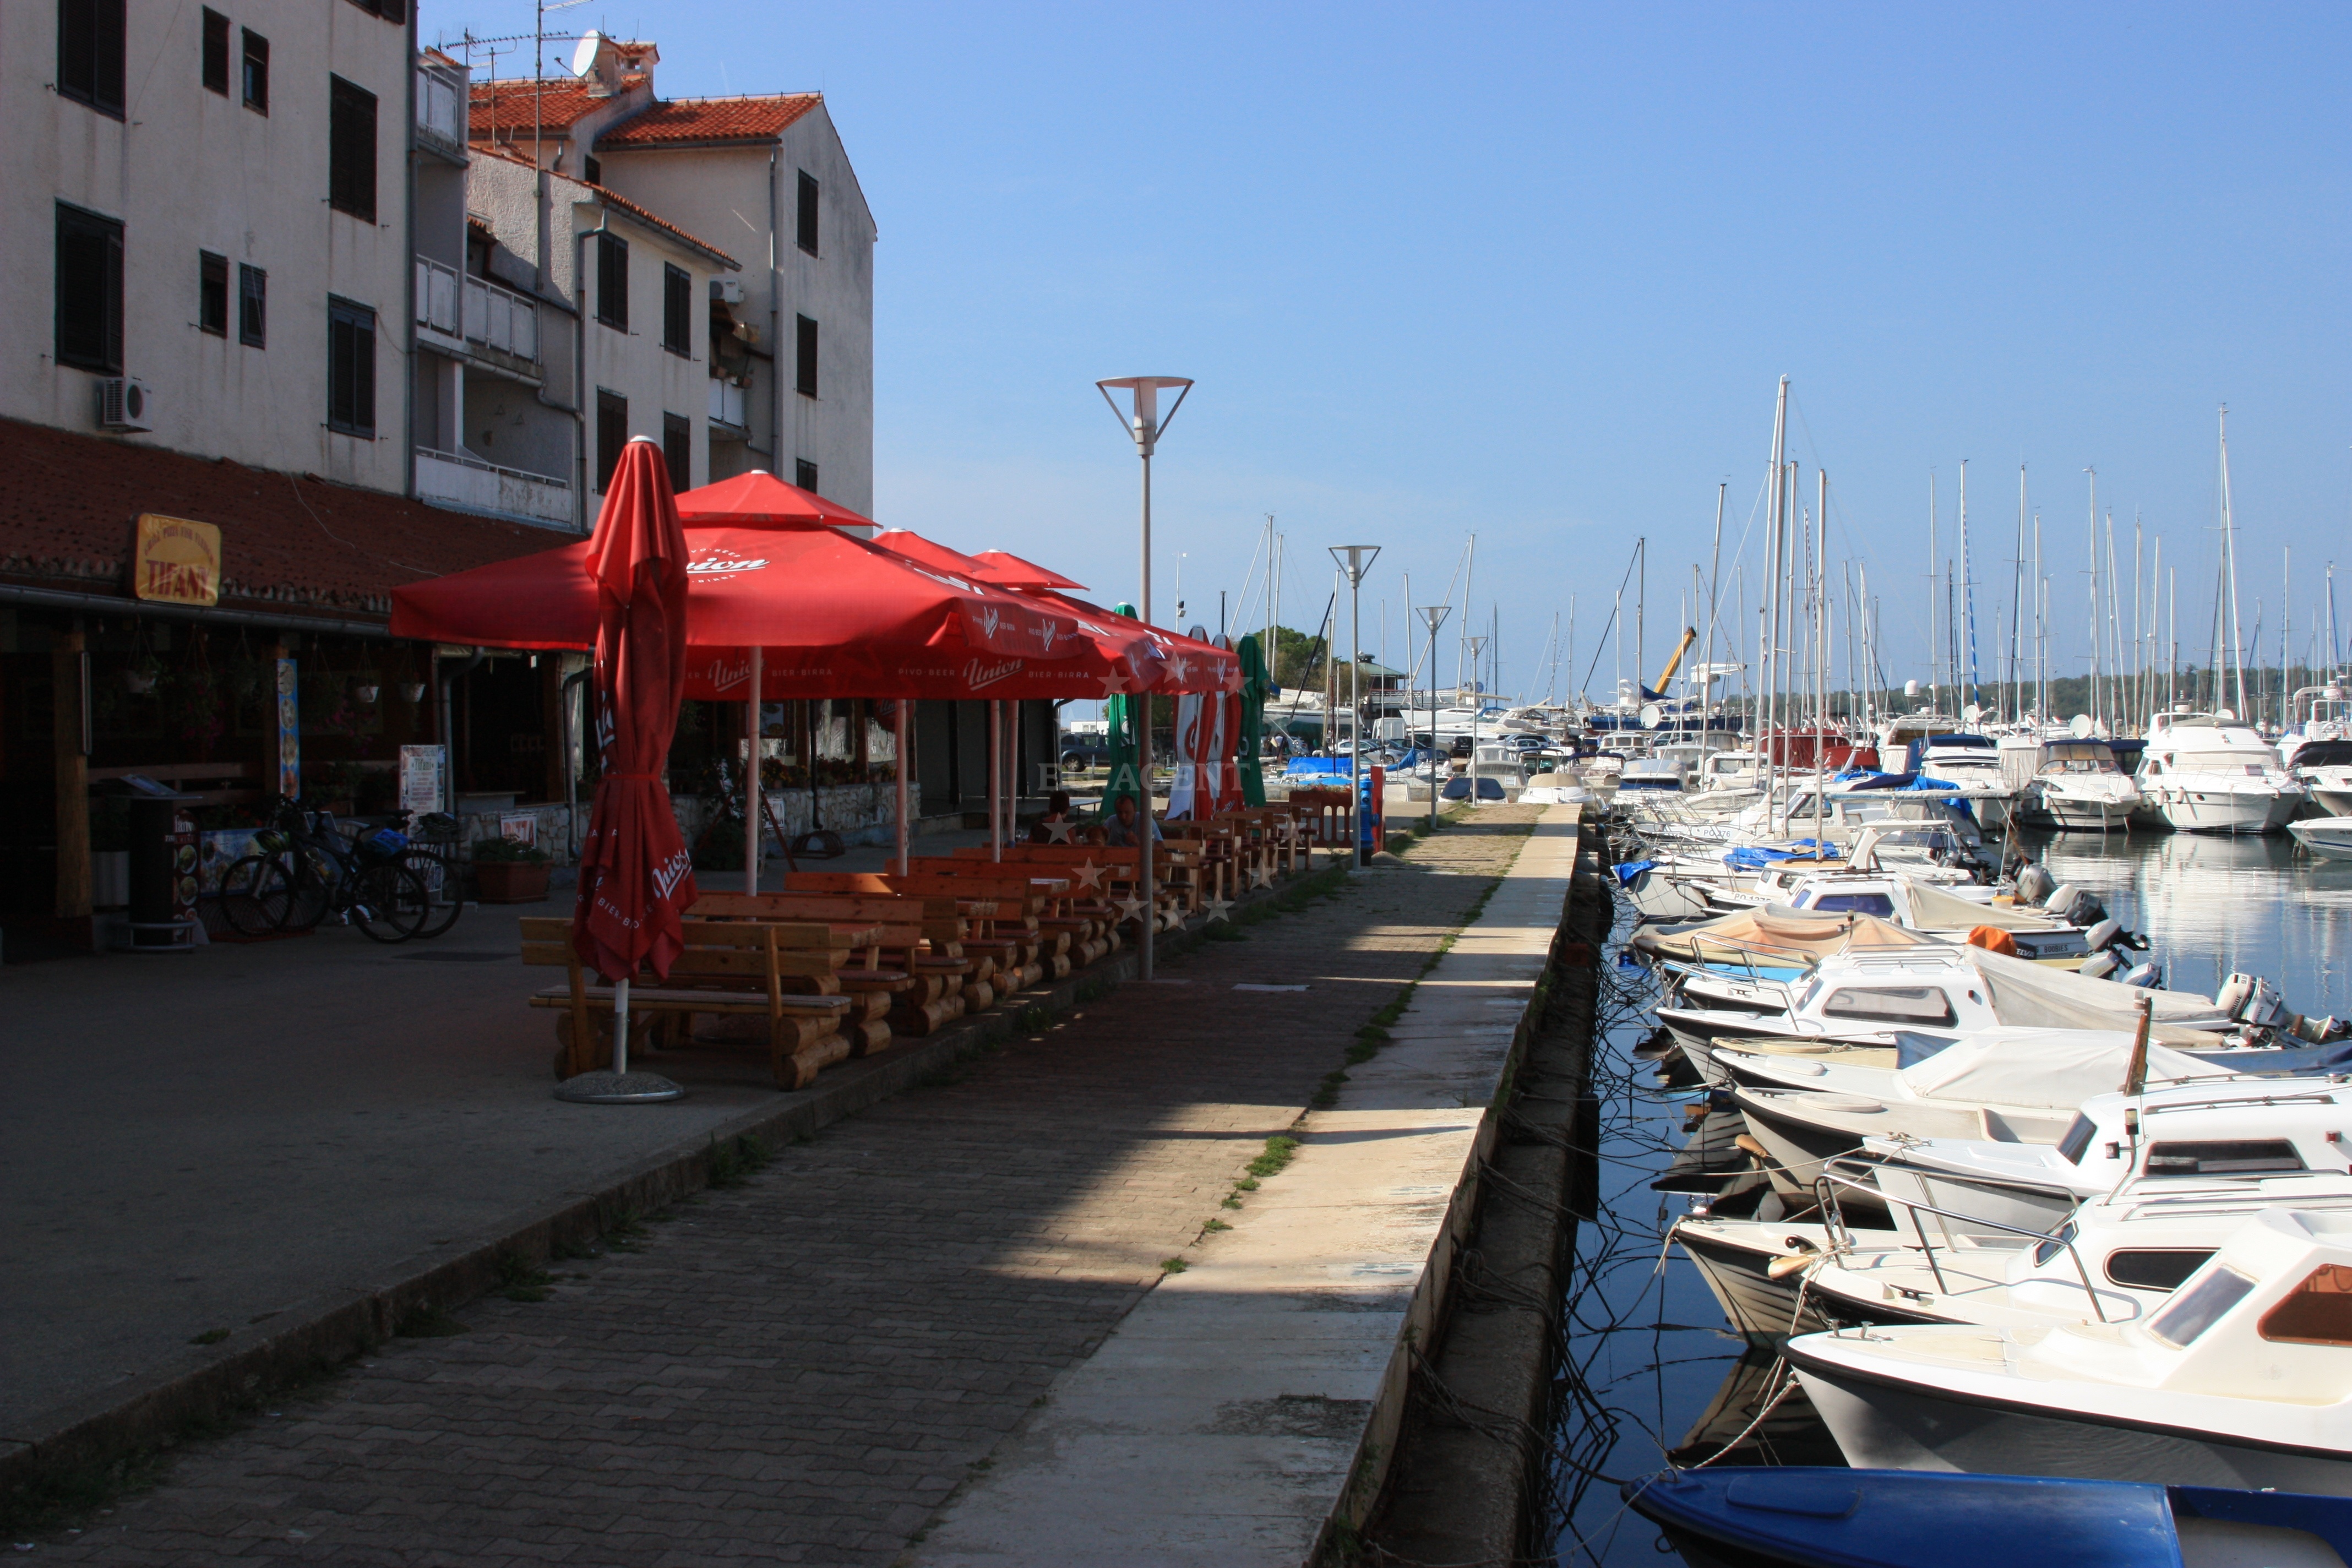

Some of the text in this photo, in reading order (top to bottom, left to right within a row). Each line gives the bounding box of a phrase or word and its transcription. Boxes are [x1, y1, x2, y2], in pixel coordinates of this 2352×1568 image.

[146, 559, 211, 600] TIFANY
[962, 657, 1025, 692] Union
[2016, 948, 2034, 957] ELVA
[2044, 944, 2068, 953] BOOBIES
